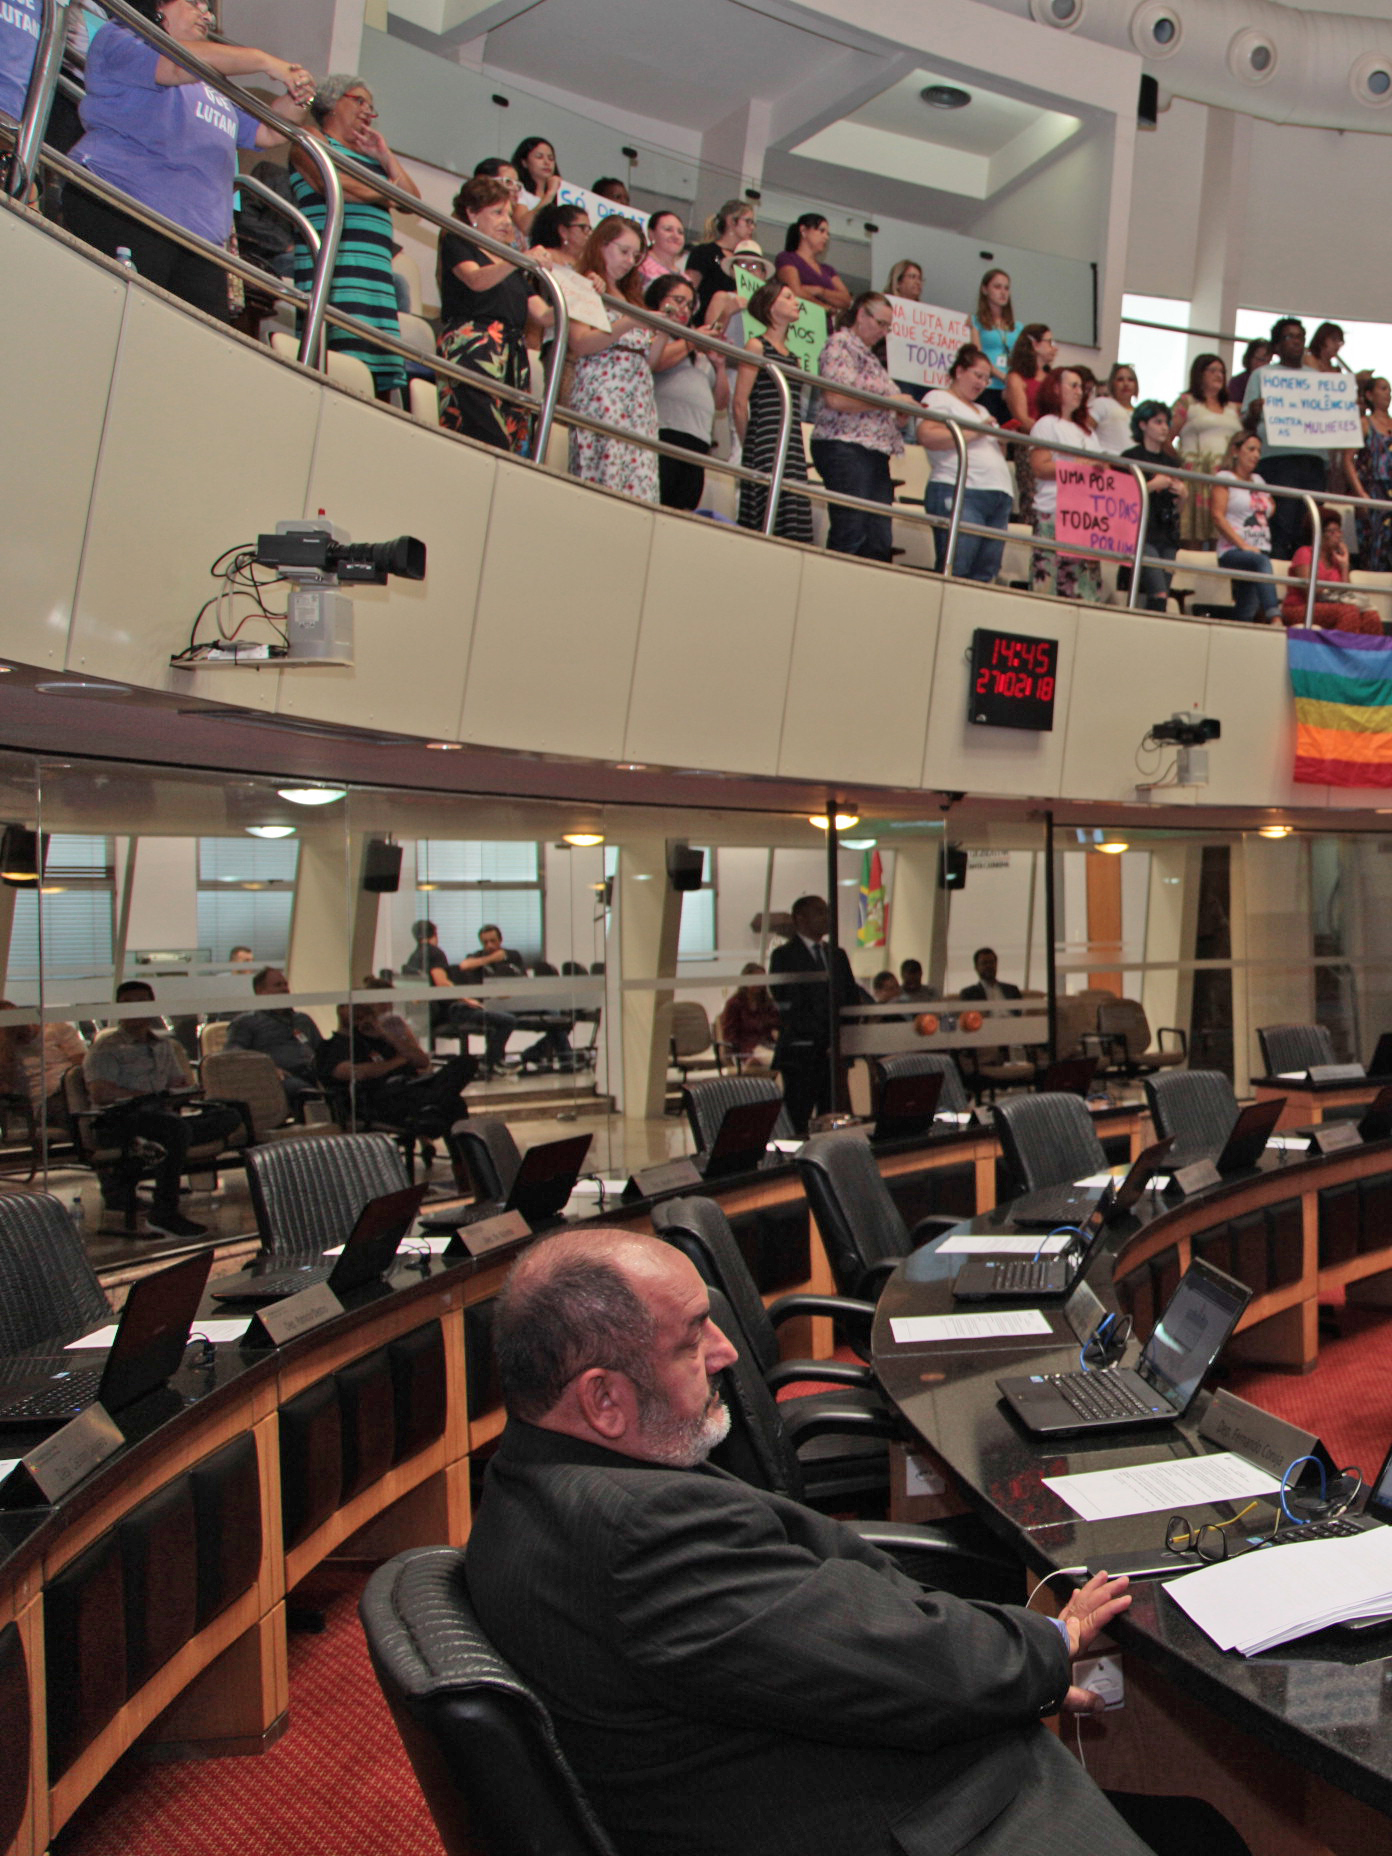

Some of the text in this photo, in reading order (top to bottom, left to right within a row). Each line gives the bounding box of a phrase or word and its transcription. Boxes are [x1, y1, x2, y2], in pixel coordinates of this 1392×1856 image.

[0, 1, 41, 40] UTAM
[195, 101, 237, 139] LUTAM
[912, 309, 945, 331] LUTA
[892, 322, 962, 352] QUE SEJAMO
[907, 344, 955, 371] TODAS
[923, 369, 953, 387] LIVR
[1263, 375, 1347, 392] HOMENS PELO
[1266, 395, 1284, 409] FIM
[1303, 419, 1358, 435] MULHERES
[1059, 469, 1116, 492] UMA POR
[1090, 493, 1139, 524] TODAS
[1061, 509, 1110, 532] TODAS
[1090, 533, 1115, 552] POR
[992, 638, 1051, 674] 14:45
